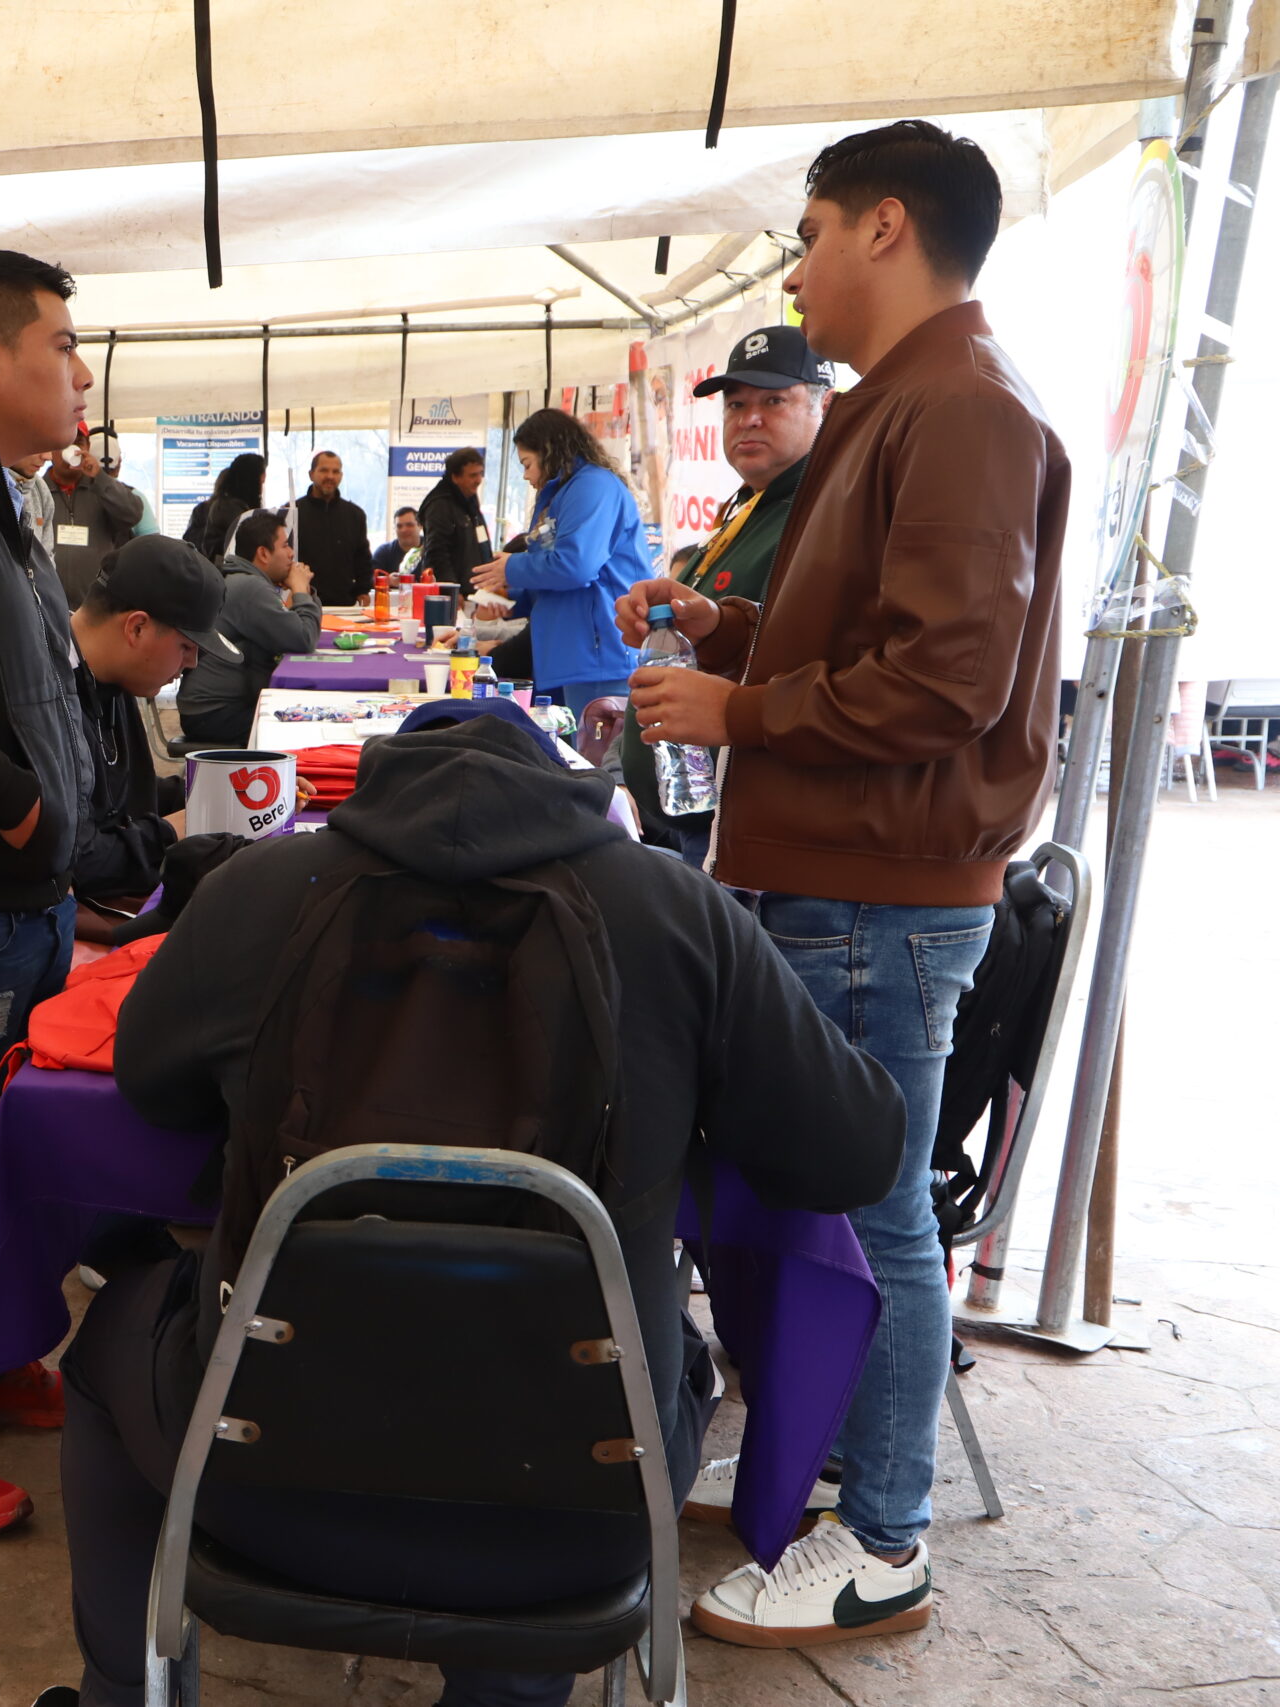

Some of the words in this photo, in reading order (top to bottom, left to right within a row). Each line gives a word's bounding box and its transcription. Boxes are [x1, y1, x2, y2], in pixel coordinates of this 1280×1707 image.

[745, 345, 770, 360] Berel
[413, 415, 462, 426] Brunnen
[248, 796, 288, 833] Berel
